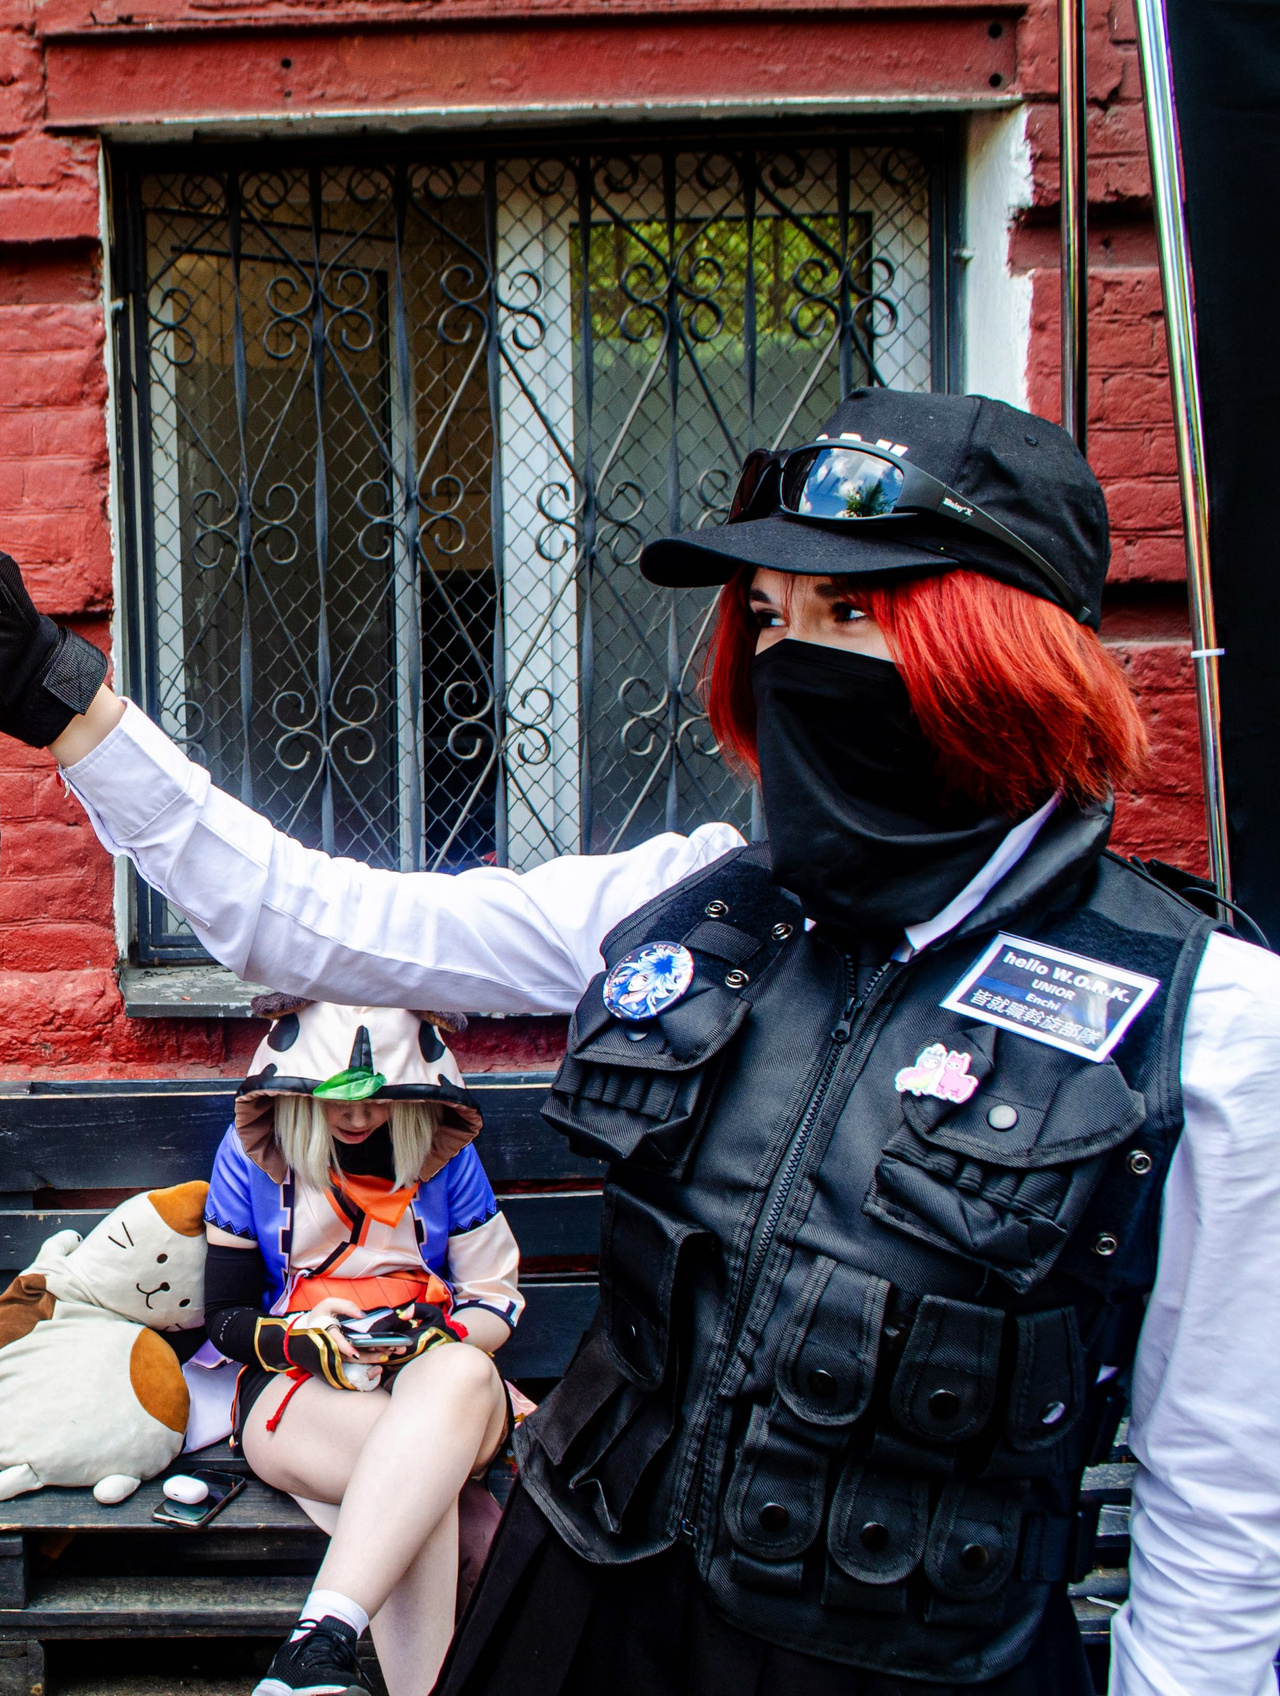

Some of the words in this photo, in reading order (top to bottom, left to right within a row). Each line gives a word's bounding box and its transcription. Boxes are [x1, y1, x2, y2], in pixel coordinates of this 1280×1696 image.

[1003, 951, 1048, 976] hello
[1052, 966, 1130, 1004] W.O.R.K.
[1031, 978, 1076, 1001] UNIOR
[1025, 992, 1060, 1011] Enchi
